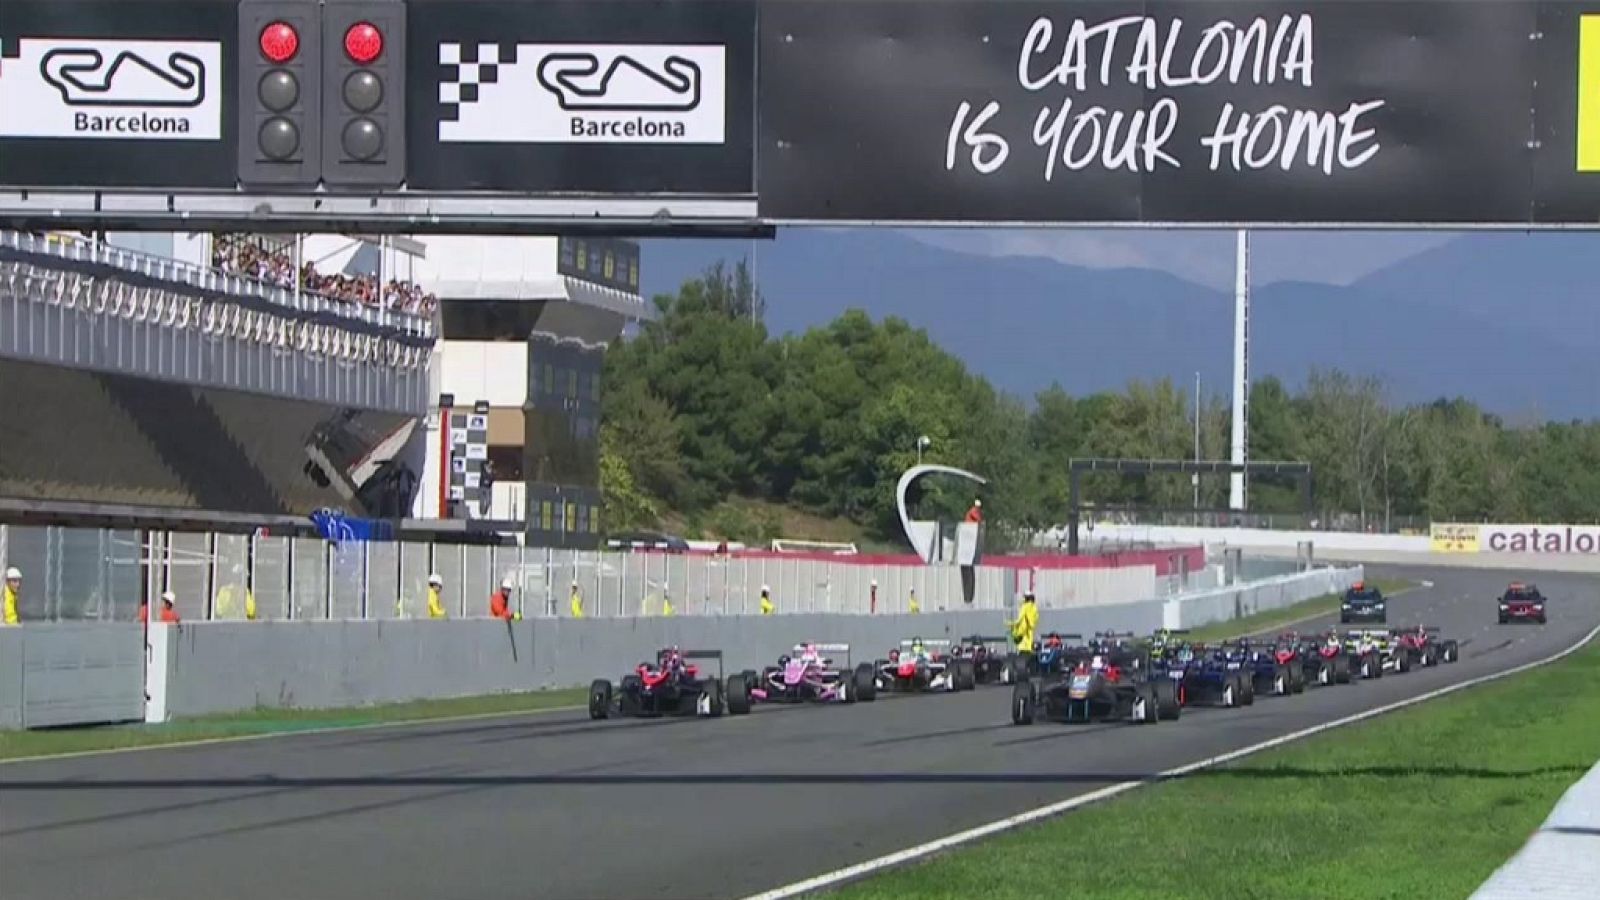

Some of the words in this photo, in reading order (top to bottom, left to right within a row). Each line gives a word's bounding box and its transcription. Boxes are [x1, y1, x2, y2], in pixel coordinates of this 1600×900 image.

[1018, 13, 1313, 91] CATALONIA
[73, 112, 190, 134] Barcelona
[570, 116, 686, 138] Barcelona
[946, 101, 1009, 173] IS
[1033, 97, 1181, 181] YOUR
[1200, 99, 1385, 176] HOME
[1489, 527, 1600, 552] catalo
